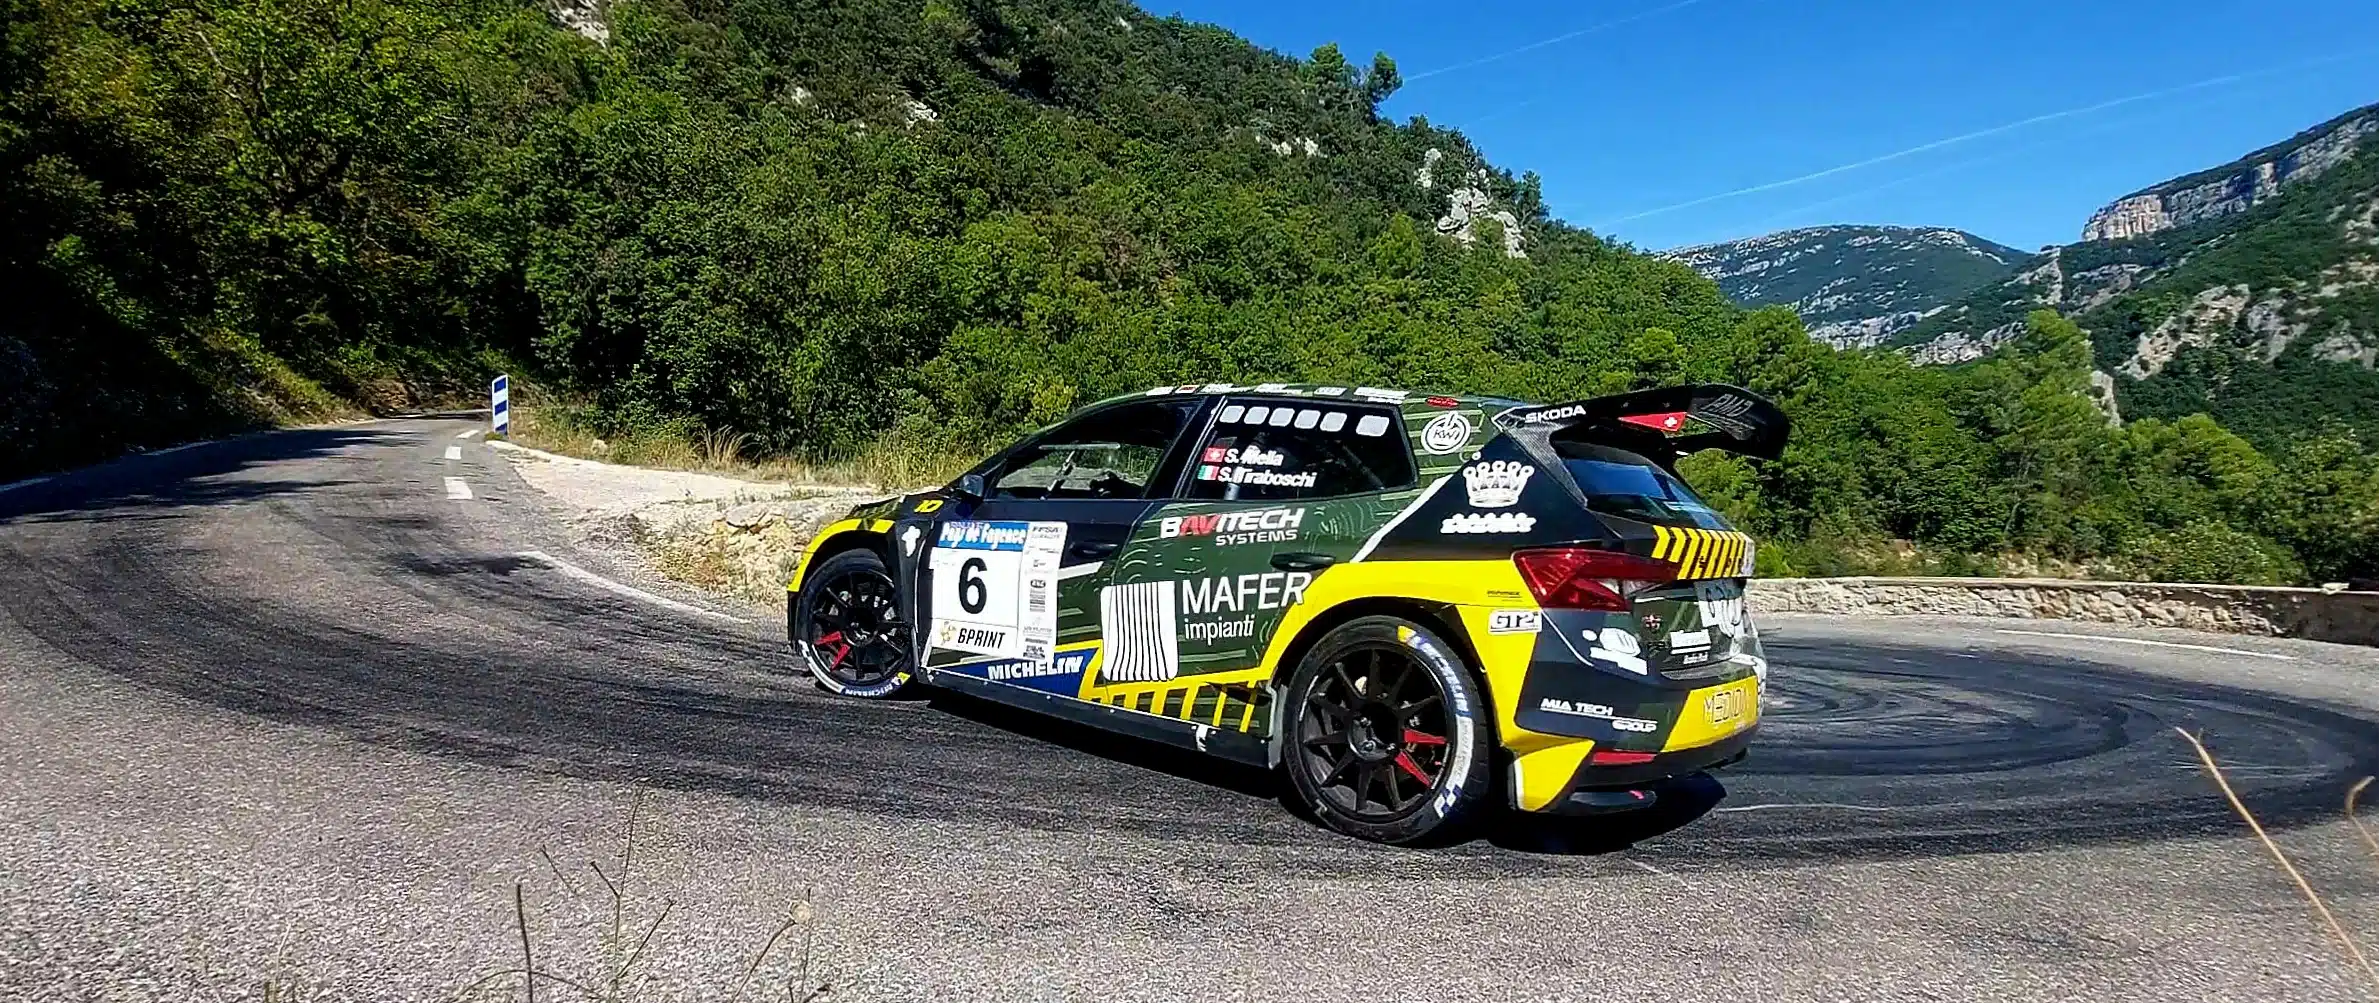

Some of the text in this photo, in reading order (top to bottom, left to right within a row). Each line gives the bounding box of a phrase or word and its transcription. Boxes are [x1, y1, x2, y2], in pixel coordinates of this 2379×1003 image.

[1525, 405, 1587, 424] SKODA
[1224, 448, 1239, 464] S.
[1160, 508, 1306, 538] BAVITECH
[1215, 529, 1298, 546] SYSTEMS
[958, 557, 988, 615] 6
[1182, 572, 1312, 615] MAFER
[1184, 613, 1255, 646] impianti
[988, 656, 1084, 680] MICHELIN
[1541, 698, 1613, 716] MIA TECH
